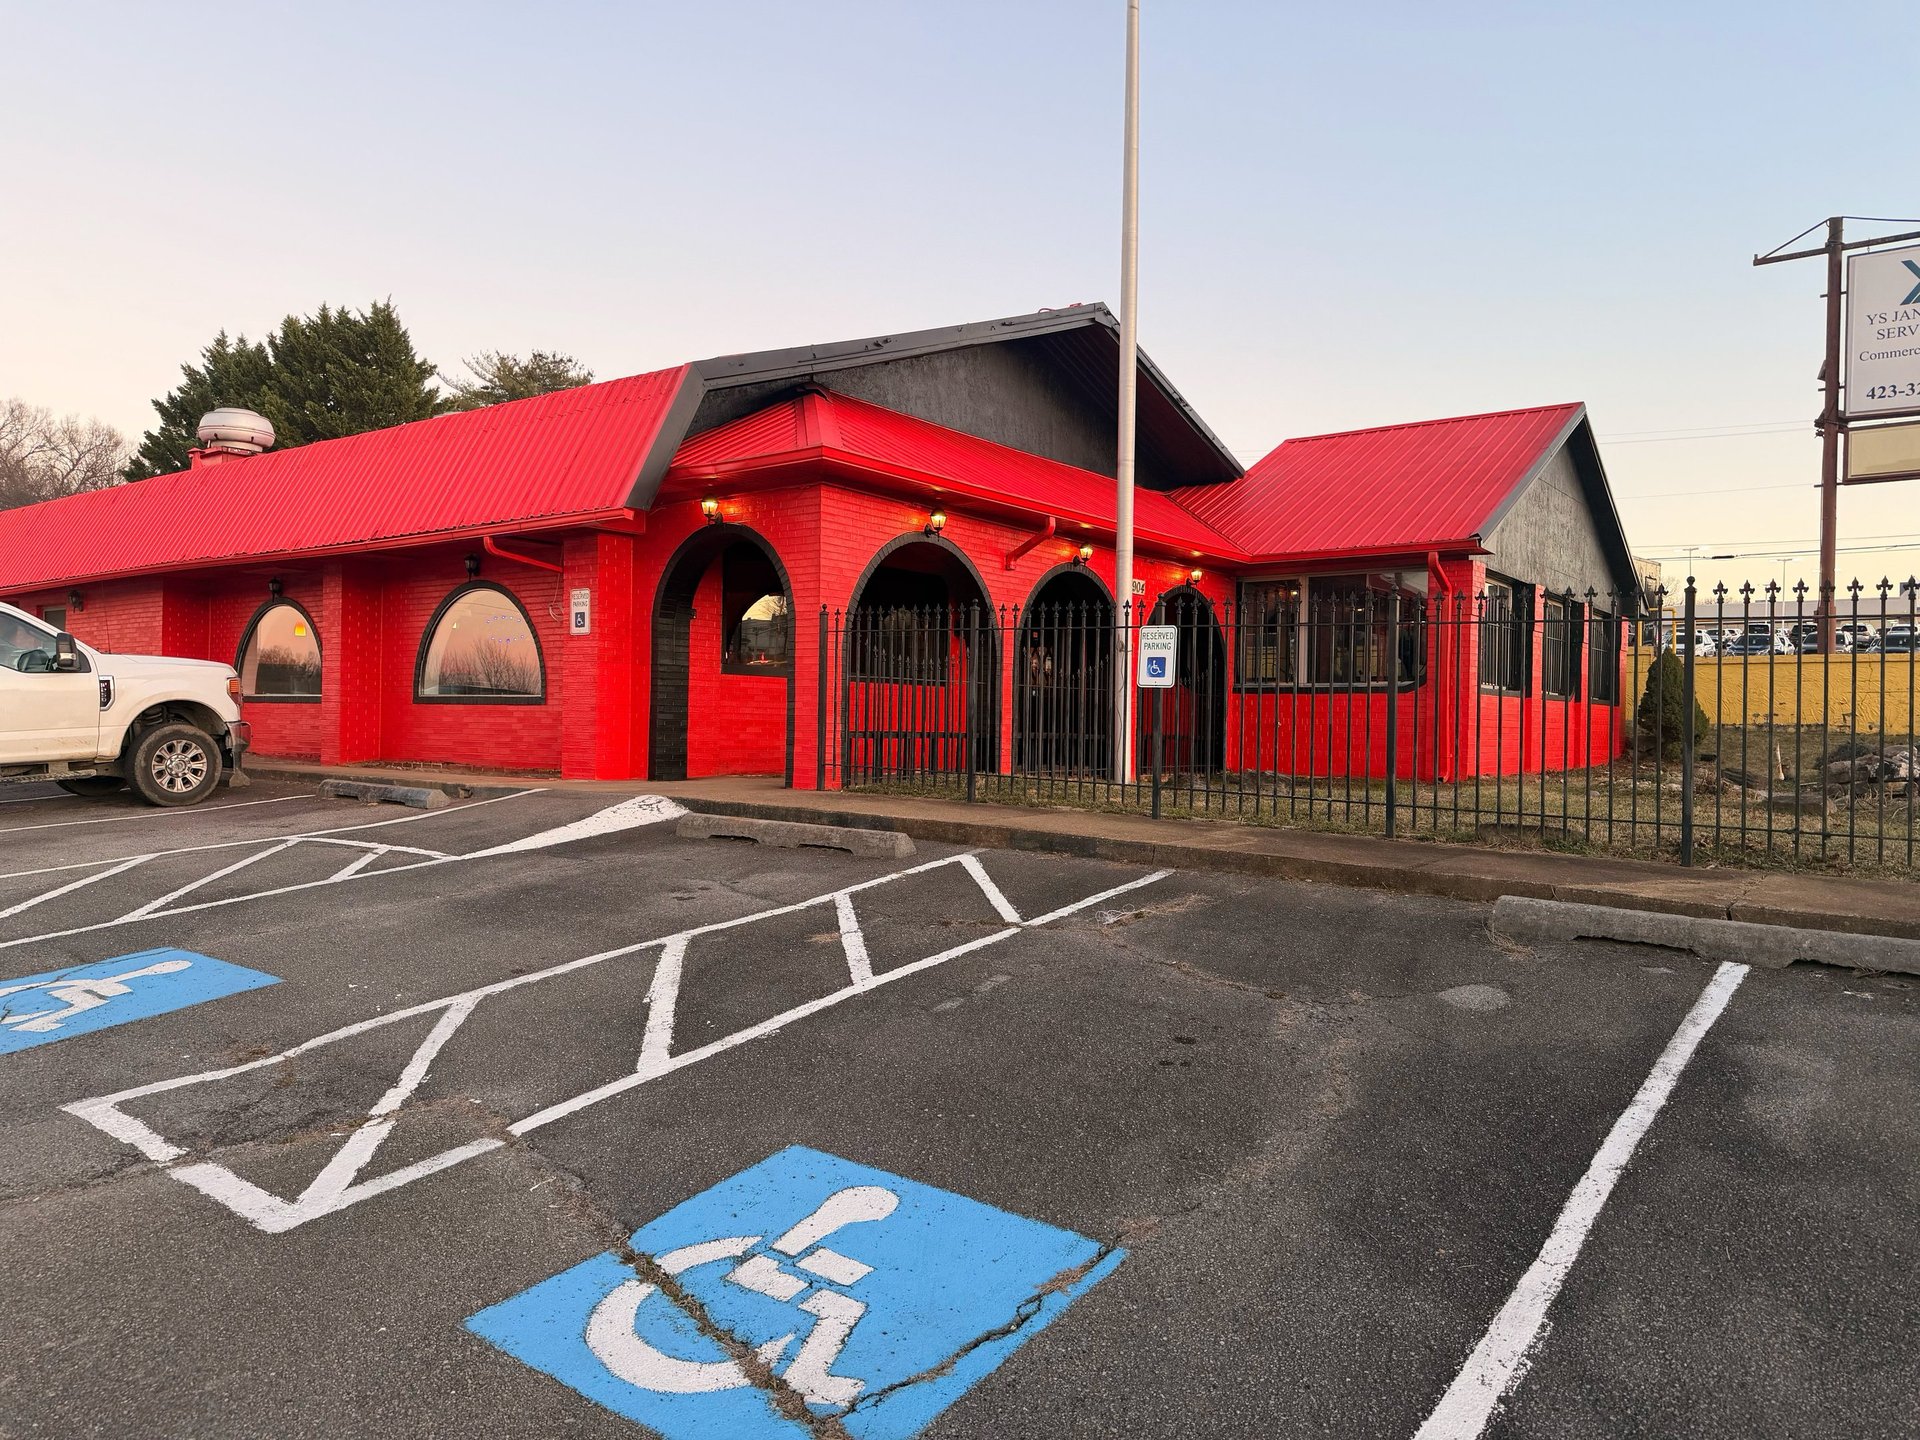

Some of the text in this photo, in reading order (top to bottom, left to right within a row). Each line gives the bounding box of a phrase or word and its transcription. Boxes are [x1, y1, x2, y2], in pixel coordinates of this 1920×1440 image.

[1866, 312, 1888, 325] YS
[1876, 324, 1920, 340] SERV
[1142, 631, 1174, 640] RESERVED
[1143, 642, 1172, 651] PARKING
